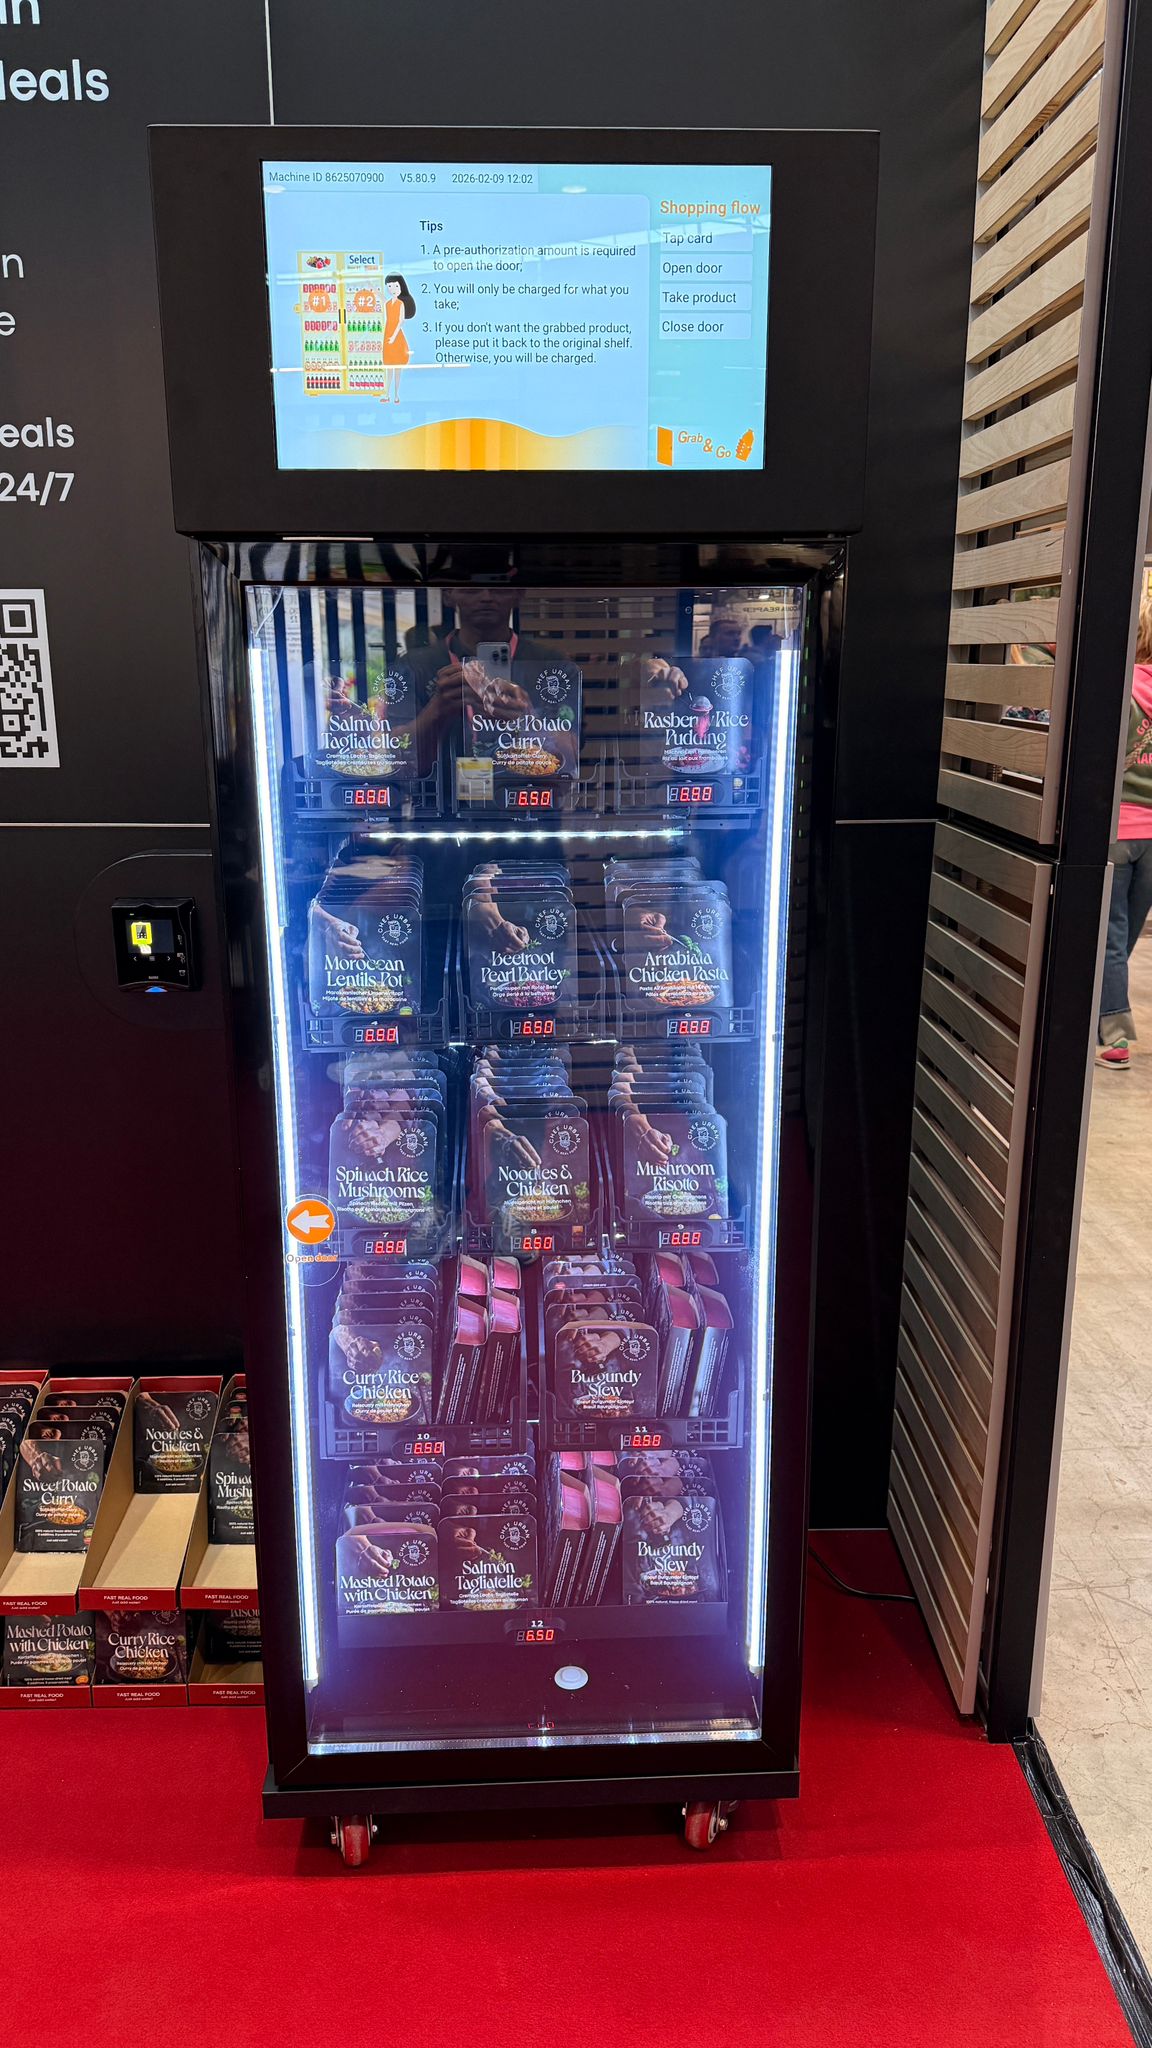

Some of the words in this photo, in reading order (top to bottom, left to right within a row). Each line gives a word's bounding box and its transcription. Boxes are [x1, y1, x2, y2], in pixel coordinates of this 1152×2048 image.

[0, 59, 110, 102] eals
[269, 171, 310, 183] Machine
[312, 172, 323, 183] ID
[325, 172, 384, 183] 8625070900
[399, 173, 436, 183] V5.80.9
[452, 174, 504, 184] 2026-02-09
[507, 174, 533, 184] 12:02
[660, 200, 727, 217] Shopping
[731, 200, 761, 214] flow
[420, 221, 443, 233] Tips
[663, 232, 684, 246] Tap
[687, 232, 713, 244] card
[421, 245, 430, 254] 1.
[433, 245, 441, 254] A
[443, 245, 535, 257] pre-authorization
[537, 247, 578, 256] amount
[580, 245, 590, 256] is
[592, 245, 636, 259] required
[349, 255, 376, 265] Select
[433, 261, 444, 271] to
[447, 263, 473, 274] open
[476, 261, 493, 271] the
[495, 261, 523, 272] door;
[663, 262, 692, 276] Open
[696, 262, 723, 274] door
[421, 284, 431, 294] 2.
[434, 284, 454, 294] You
[457, 283, 475, 294] will
[477, 284, 499, 297] only
[502, 284, 515, 294] be
[518, 284, 561, 297] charged
[563, 284, 578, 294] for
[581, 284, 607, 294] what
[610, 286, 629, 297] you
[312, 296, 326, 307] #1
[358, 296, 374, 307] #2
[434, 299, 459, 310] take;
[662, 291, 690, 303] Take
[692, 291, 737, 305] product
[422, 322, 432, 332] 3.
[435, 322, 443, 332] If
[445, 324, 464, 335] you
[466, 322, 492, 333] don't
[494, 323, 520, 333] want
[523, 322, 538, 333] the
[542, 322, 586, 336] grabbed
[588, 323, 632, 336] product,
[662, 321, 694, 333] Close
[697, 321, 724, 332] door
[435, 338, 470, 350] please
[472, 339, 489, 350] put
[492, 338, 499, 348] it
[502, 338, 527, 348] back
[530, 339, 541, 348] to
[543, 338, 560, 348] the
[562, 338, 601, 350] original
[604, 338, 633, 348] shelf.
[435, 353, 491, 364] Otherwise,
[493, 355, 513, 365] you
[516, 353, 532, 363] will
[535, 353, 548, 363] be
[551, 353, 596, 366] charged.
[678, 430, 703, 443] Grab
[703, 438, 713, 452] &
[716, 445, 731, 458] Go
[0, 472, 75, 506] 24/7
[536, 670, 549, 690] CHEF
[552, 669, 571, 690] URBAN
[329, 715, 391, 732] Salmon
[472, 714, 523, 732] Sweet
[524, 714, 572, 732] Potato
[716, 711, 749, 727] Rice
[321, 732, 401, 754] Tagliatelle
[498, 732, 546, 754] Curry
[377, 914, 390, 933] CHEF
[393, 913, 412, 934] URBAN
[324, 954, 405, 971] Moroccan
[491, 951, 555, 967] Beetroot
[645, 951, 713, 967] Arrabiata
[327, 971, 377, 987] Lentils
[380, 971, 404, 987] Pot
[481, 966, 515, 983] Pearl
[518, 966, 567, 985] Barley
[629, 967, 690, 983] Chicken
[693, 966, 729, 981] Pasta
[549, 1126, 560, 1143] CHEF
[564, 1125, 580, 1143] URBAN
[336, 1166, 395, 1184] Spinach
[397, 1167, 428, 1182] Rice
[499, 1166, 558, 1181] Noodles
[560, 1164, 572, 1179] &
[636, 1161, 715, 1175] Mushroom
[338, 1183, 426, 1198] Mushrooms
[507, 1182, 569, 1196] Chicken
[653, 1177, 699, 1191] Risotto
[286, 1254, 315, 1263] Open
[343, 1370, 387, 1388] Curry
[388, 1370, 419, 1384] Rice
[571, 1370, 641, 1386] Burgundy
[350, 1385, 412, 1399] Chicken
[588, 1383, 623, 1396] Stew
[146, 1428, 192, 1440] Noodles
[194, 1427, 204, 1440] &
[72, 1446, 82, 1461] CHEF
[84, 1445, 98, 1461] URBAN
[152, 1440, 200, 1452] Chicken
[23, 1479, 61, 1492] Sweet
[62, 1479, 97, 1492] Potato
[41, 1492, 77, 1508] Curry
[500, 1523, 510, 1540] CHEF
[514, 1521, 530, 1539] URBAN
[638, 1541, 704, 1561] Burgundy
[462, 1561, 515, 1574] Salmon
[655, 1556, 688, 1571] Stew
[341, 1575, 393, 1588] Mashed
[395, 1574, 435, 1587] Potato
[455, 1575, 523, 1594] Tagliatelle
[344, 1588, 373, 1602] with
[375, 1587, 432, 1601] Chicken
[7, 1625, 54, 1638] Mashed
[57, 1624, 92, 1637] Potato
[10, 1639, 36, 1652] with
[37, 1638, 89, 1652] Chicken
[108, 1633, 147, 1649] Curry
[148, 1633, 175, 1645] Rice
[115, 1646, 169, 1658] Chicken
